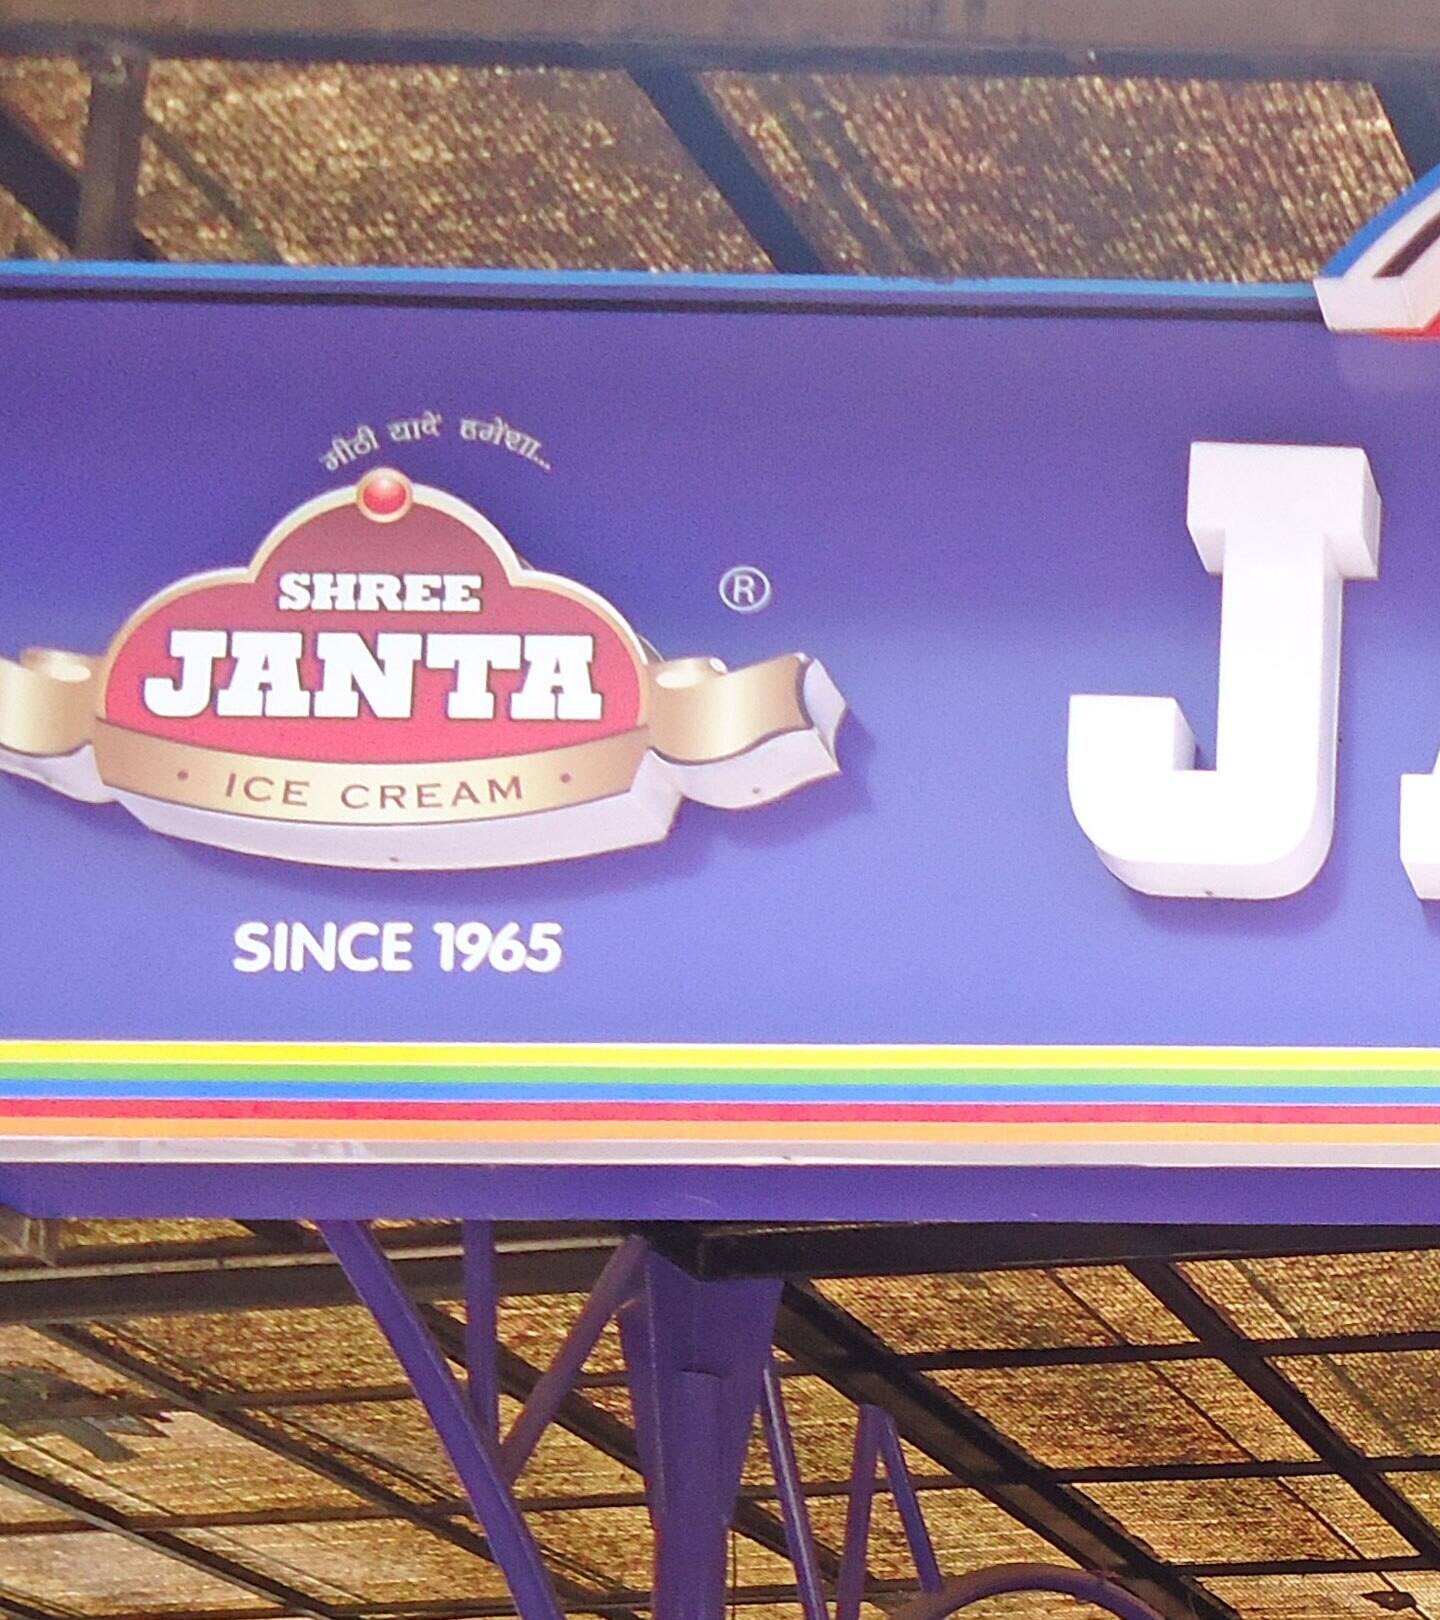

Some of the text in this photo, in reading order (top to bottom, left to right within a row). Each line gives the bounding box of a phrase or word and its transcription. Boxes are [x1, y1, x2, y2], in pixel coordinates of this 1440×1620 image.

[277, 572, 483, 613] SHREE
[143, 630, 604, 721] JANTA
[224, 772, 525, 811] ICE CREAM
[232, 921, 563, 973] SINCE 1965
